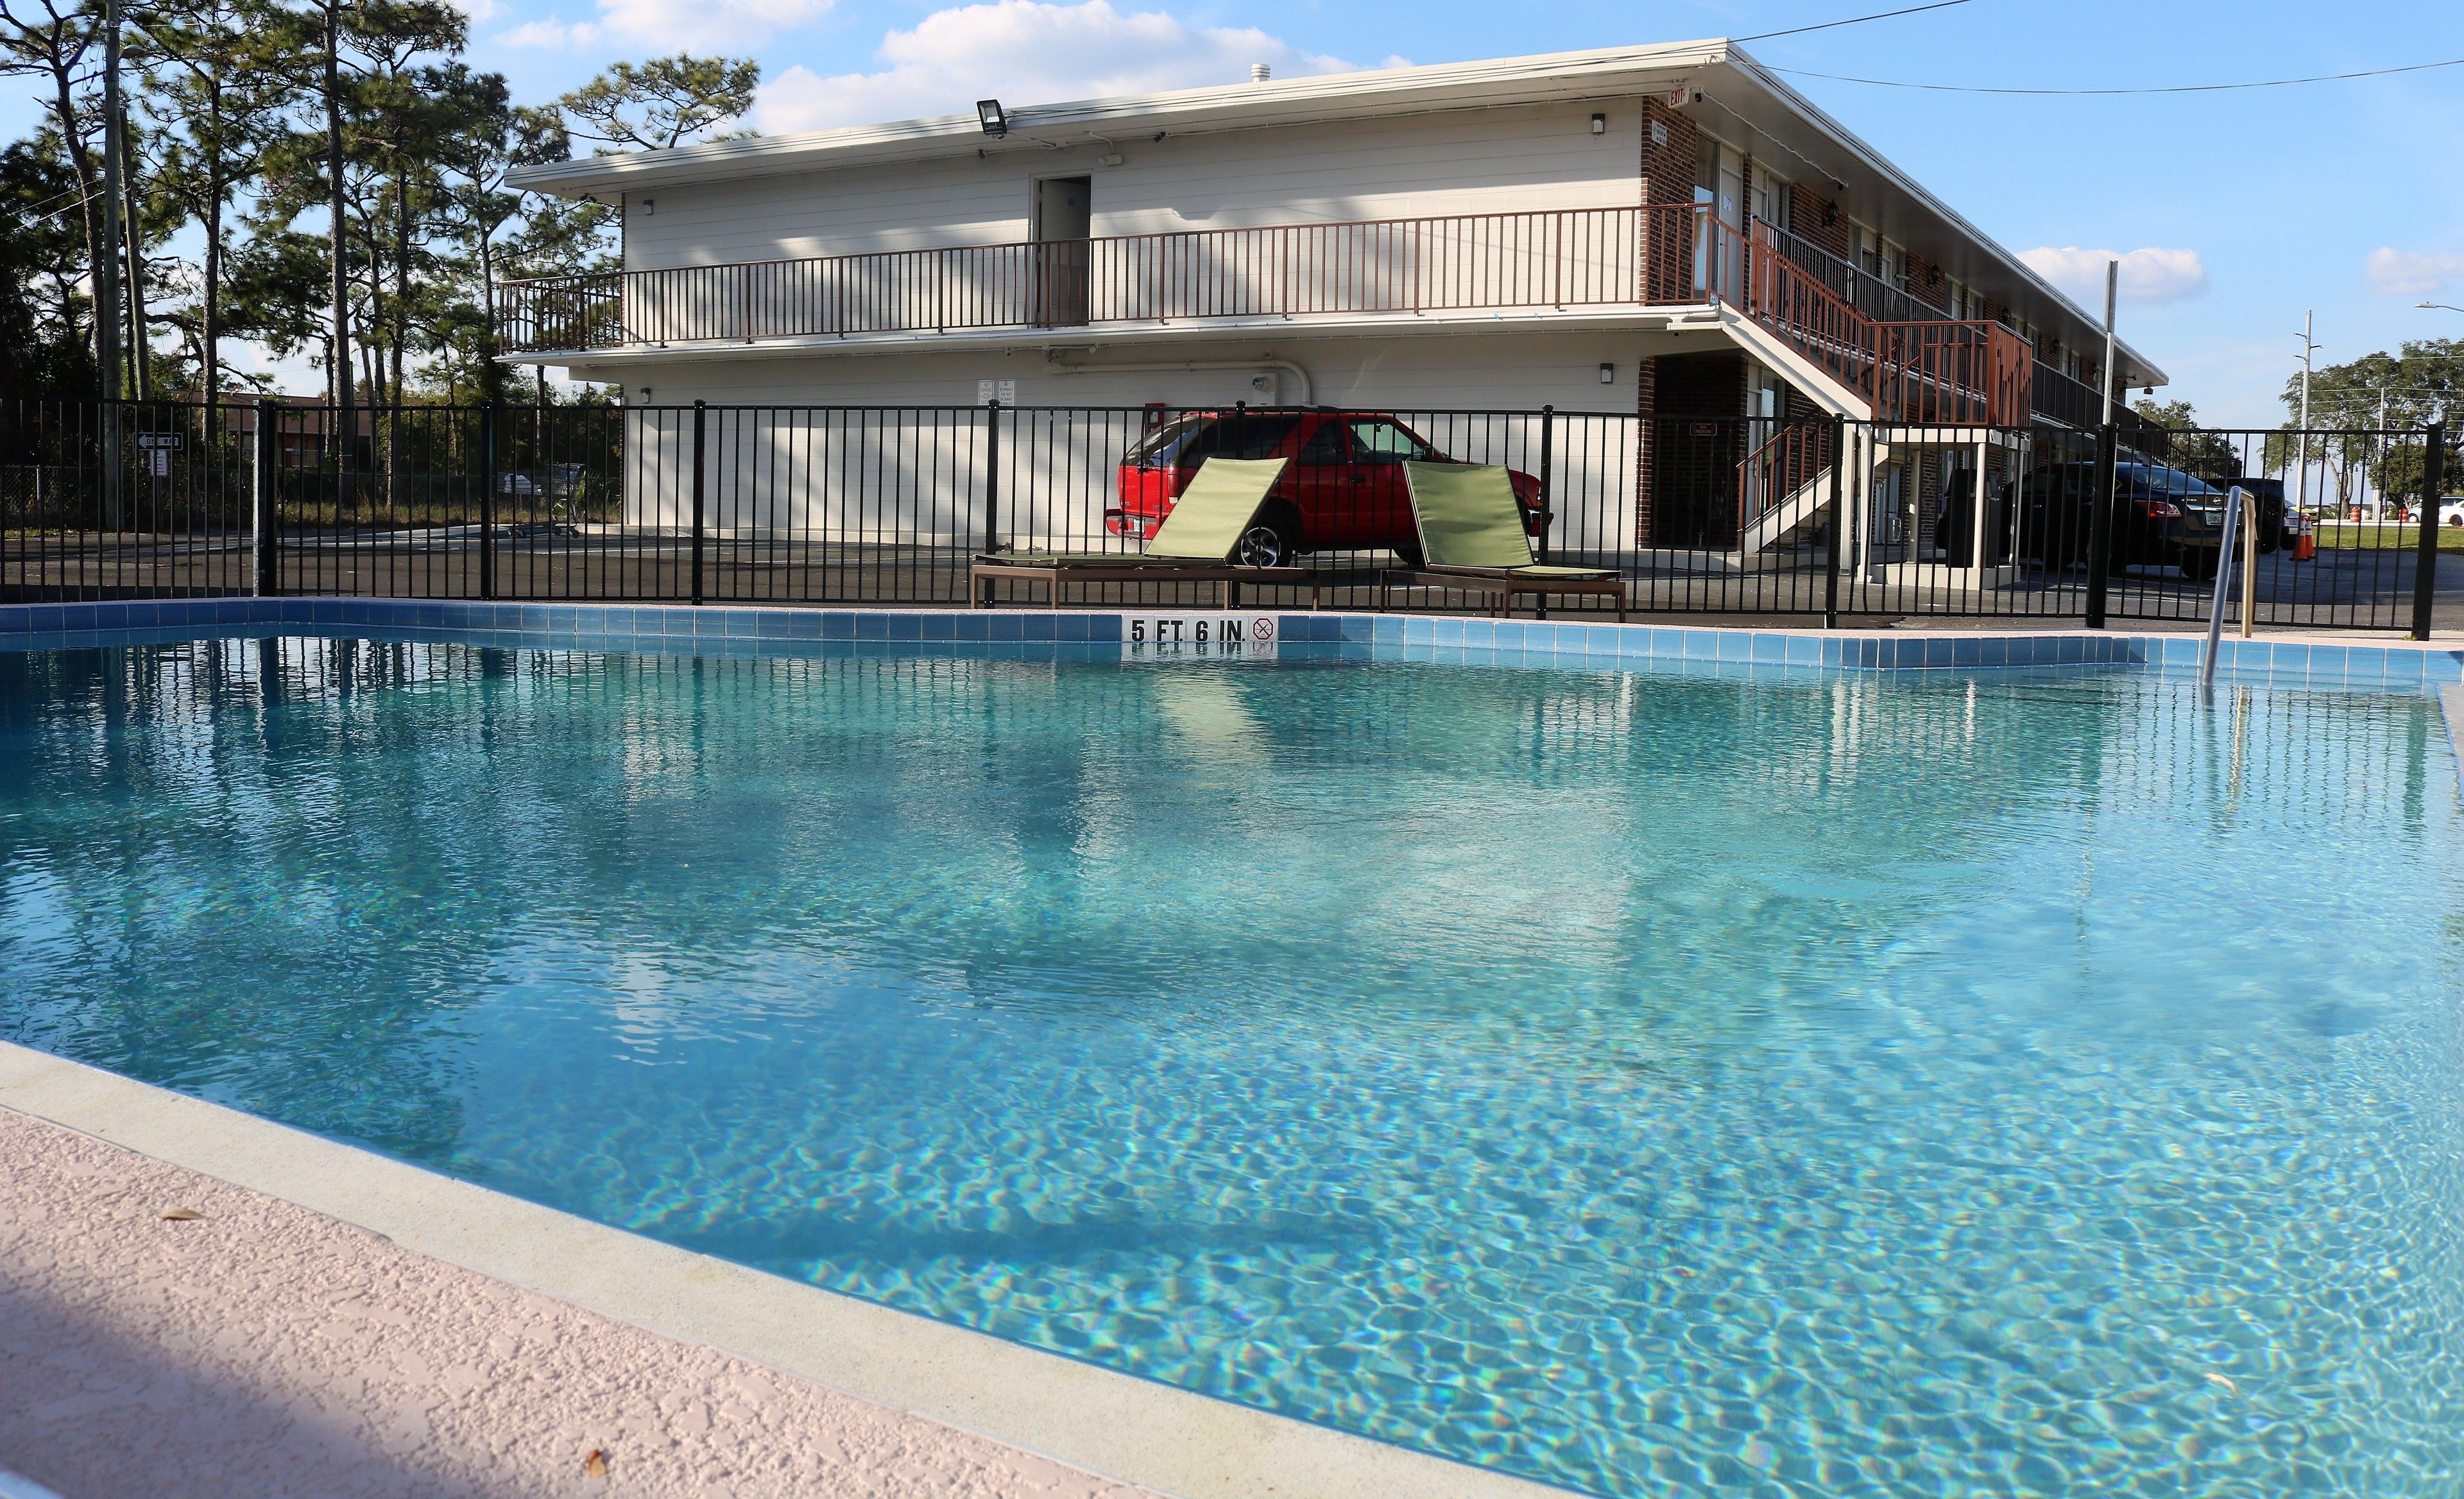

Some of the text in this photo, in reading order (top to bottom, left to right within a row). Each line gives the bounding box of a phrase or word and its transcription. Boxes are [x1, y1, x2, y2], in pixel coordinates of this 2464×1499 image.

[1671, 89, 1684, 105] EXIT
[1131, 620, 1245, 642] 5 FT. 6 IN.
